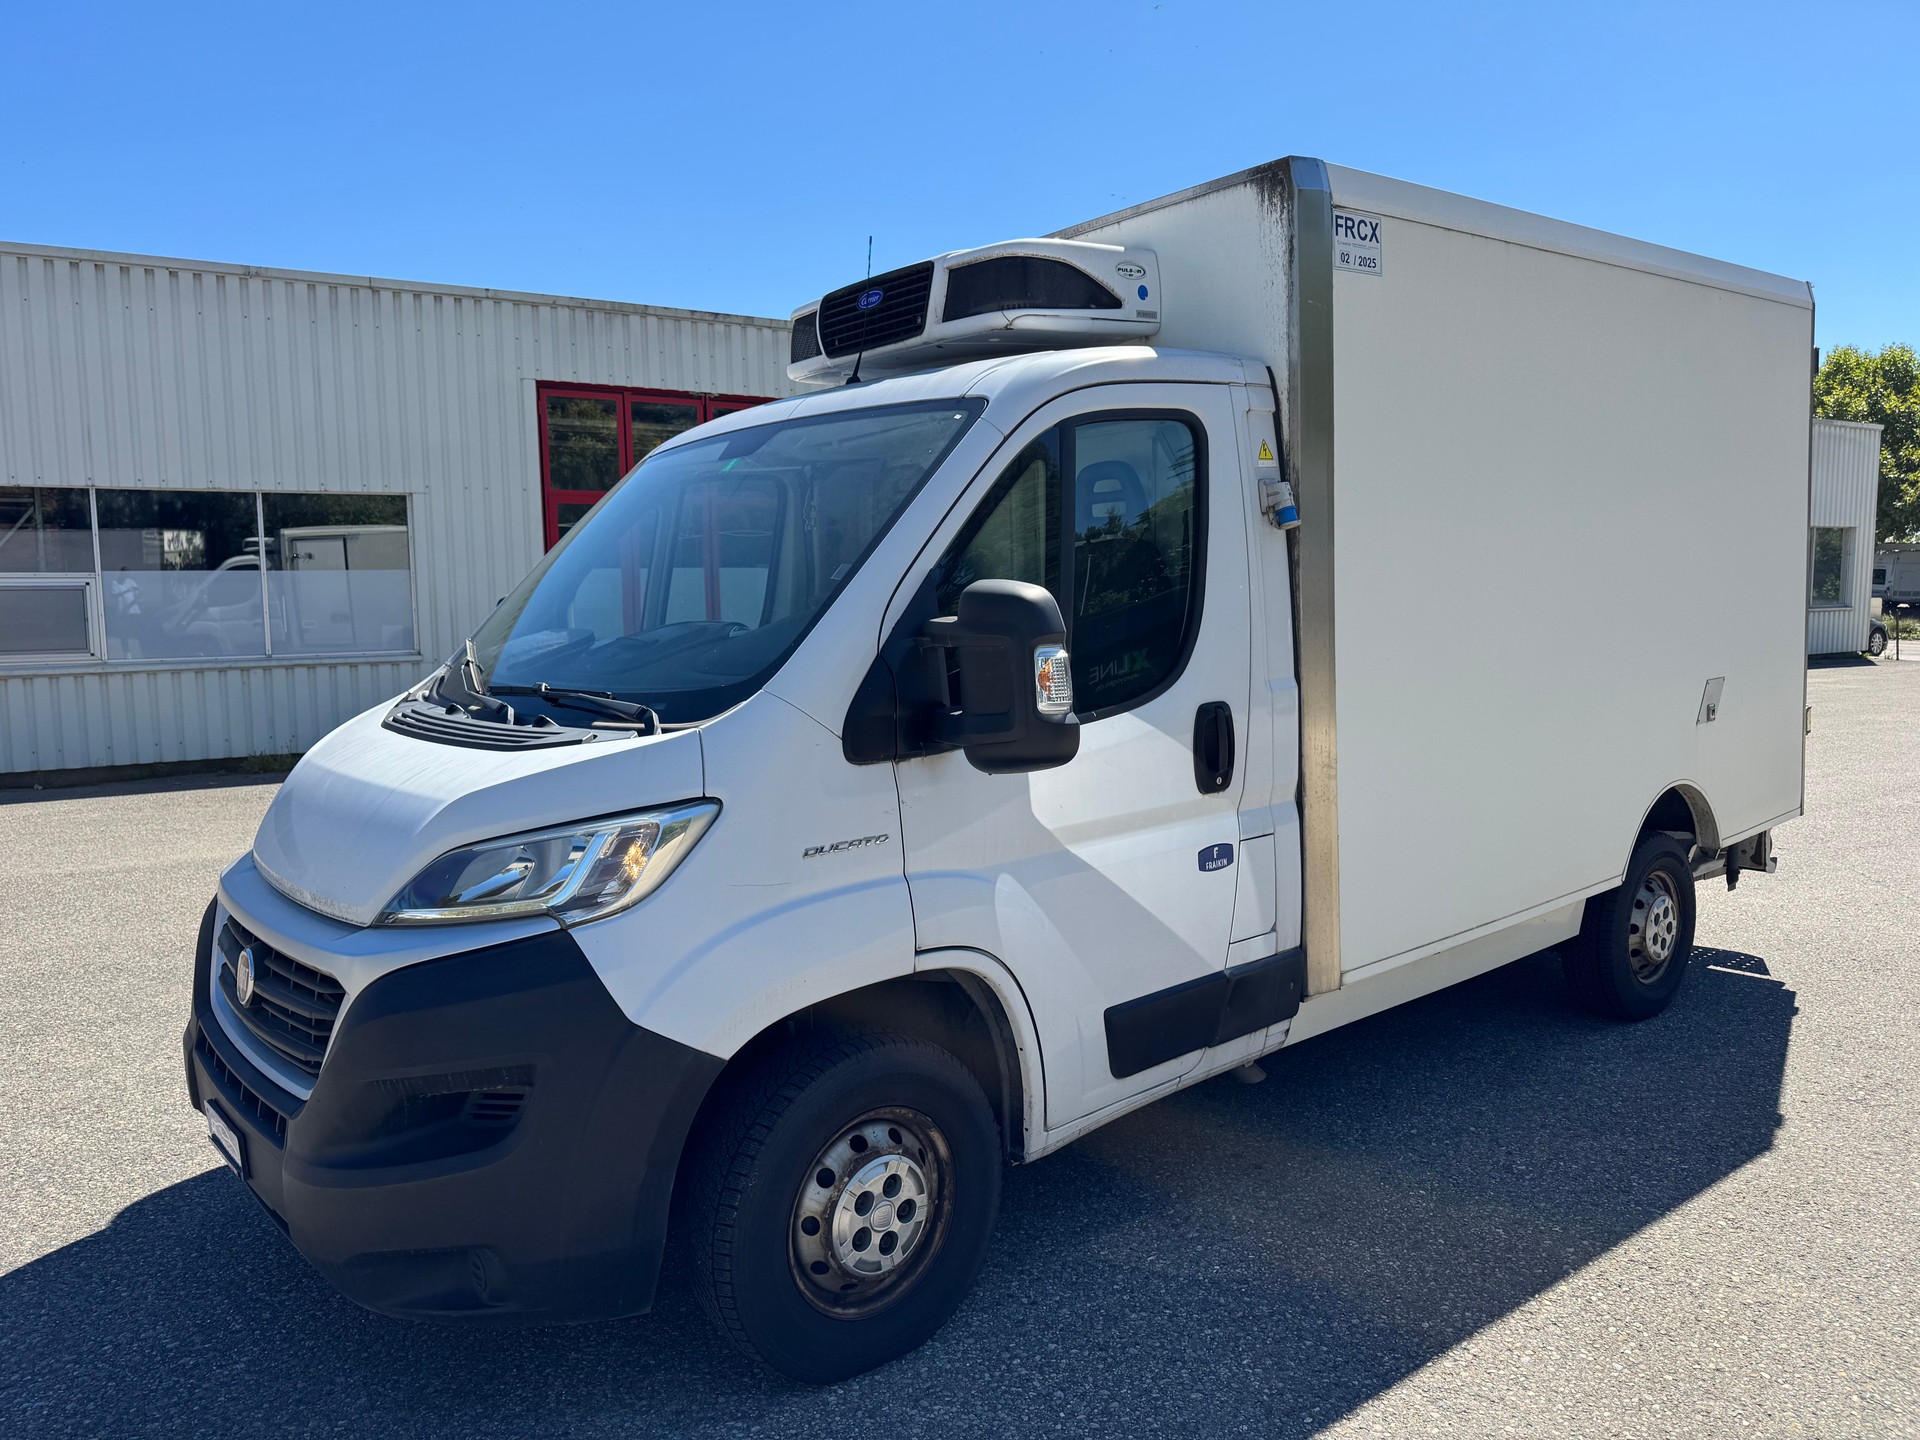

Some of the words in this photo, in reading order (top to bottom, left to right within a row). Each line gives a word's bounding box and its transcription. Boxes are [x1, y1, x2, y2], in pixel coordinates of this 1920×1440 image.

[1335, 214, 1380, 244] FRCX
[1340, 252, 1350, 264] 02
[1358, 255, 1377, 269] 2025
[802, 833, 889, 858] DUCATO
[1213, 846, 1219, 859] F
[1205, 858, 1228, 870] FRAIKIN
